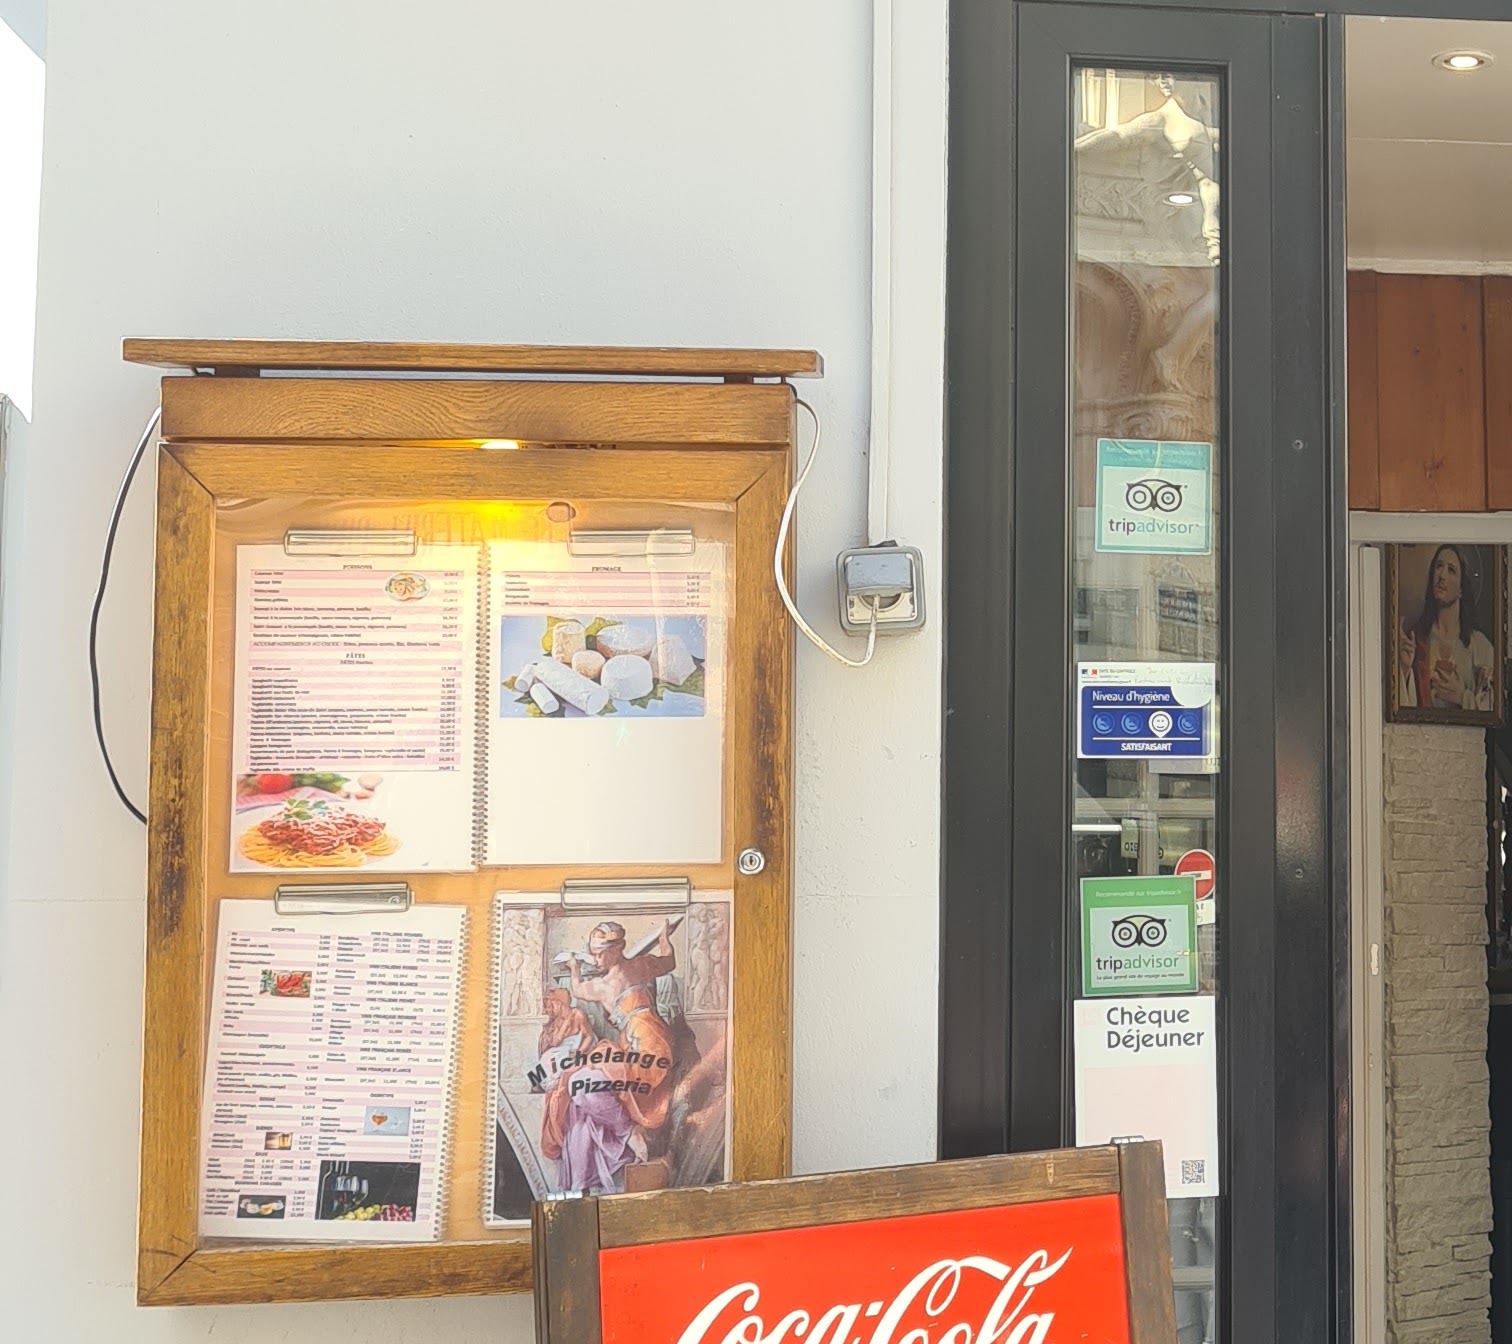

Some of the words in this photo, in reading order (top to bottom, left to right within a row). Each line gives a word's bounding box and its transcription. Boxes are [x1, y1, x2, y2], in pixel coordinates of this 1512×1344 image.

[1108, 517, 1195, 536] tripadvisor
[1092, 690, 1124, 702] Niveau
[1120, 742, 1173, 752] SATISFAISANT
[1096, 954, 1179, 973] tripadvisor
[1106, 1005, 1190, 1028] Chèque
[1107, 1029, 1204, 1052] Déjeuner
[571, 1078, 651, 1097] Pizzeria
